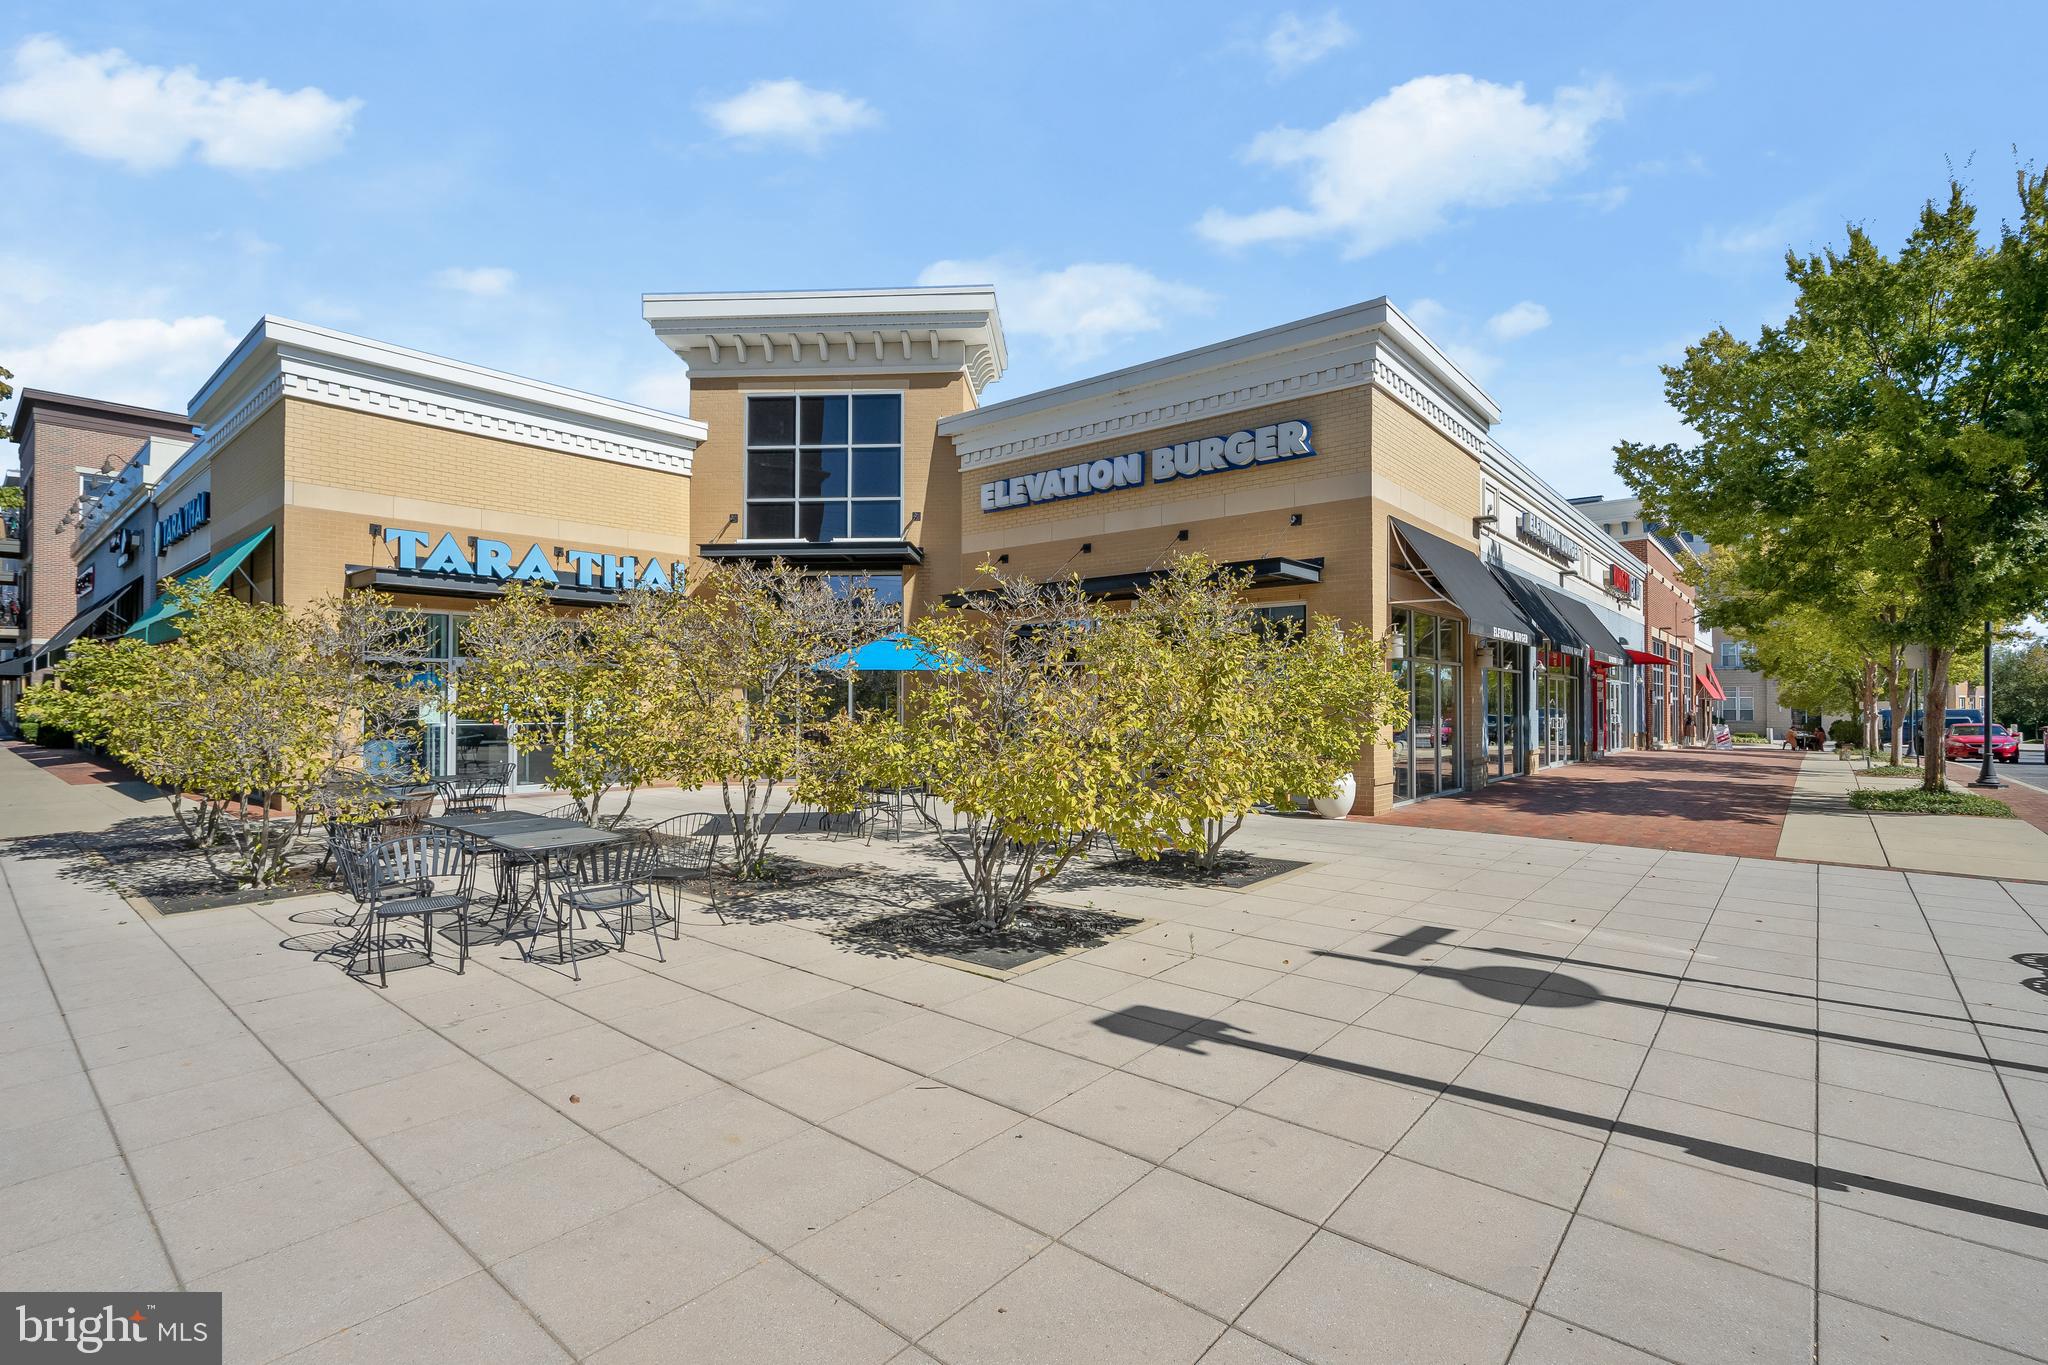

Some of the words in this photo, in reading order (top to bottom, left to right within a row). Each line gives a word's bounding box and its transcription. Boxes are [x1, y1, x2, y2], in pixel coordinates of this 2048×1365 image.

[980, 452, 1144, 513] ELEVATION
[1152, 419, 1316, 483] BURGER
[162, 507, 184, 548] TARA
[183, 491, 210, 534] THAI
[384, 527, 560, 583] TARA
[1493, 626, 1514, 640] ELEVATION
[1514, 631, 1528, 643] BURGER
